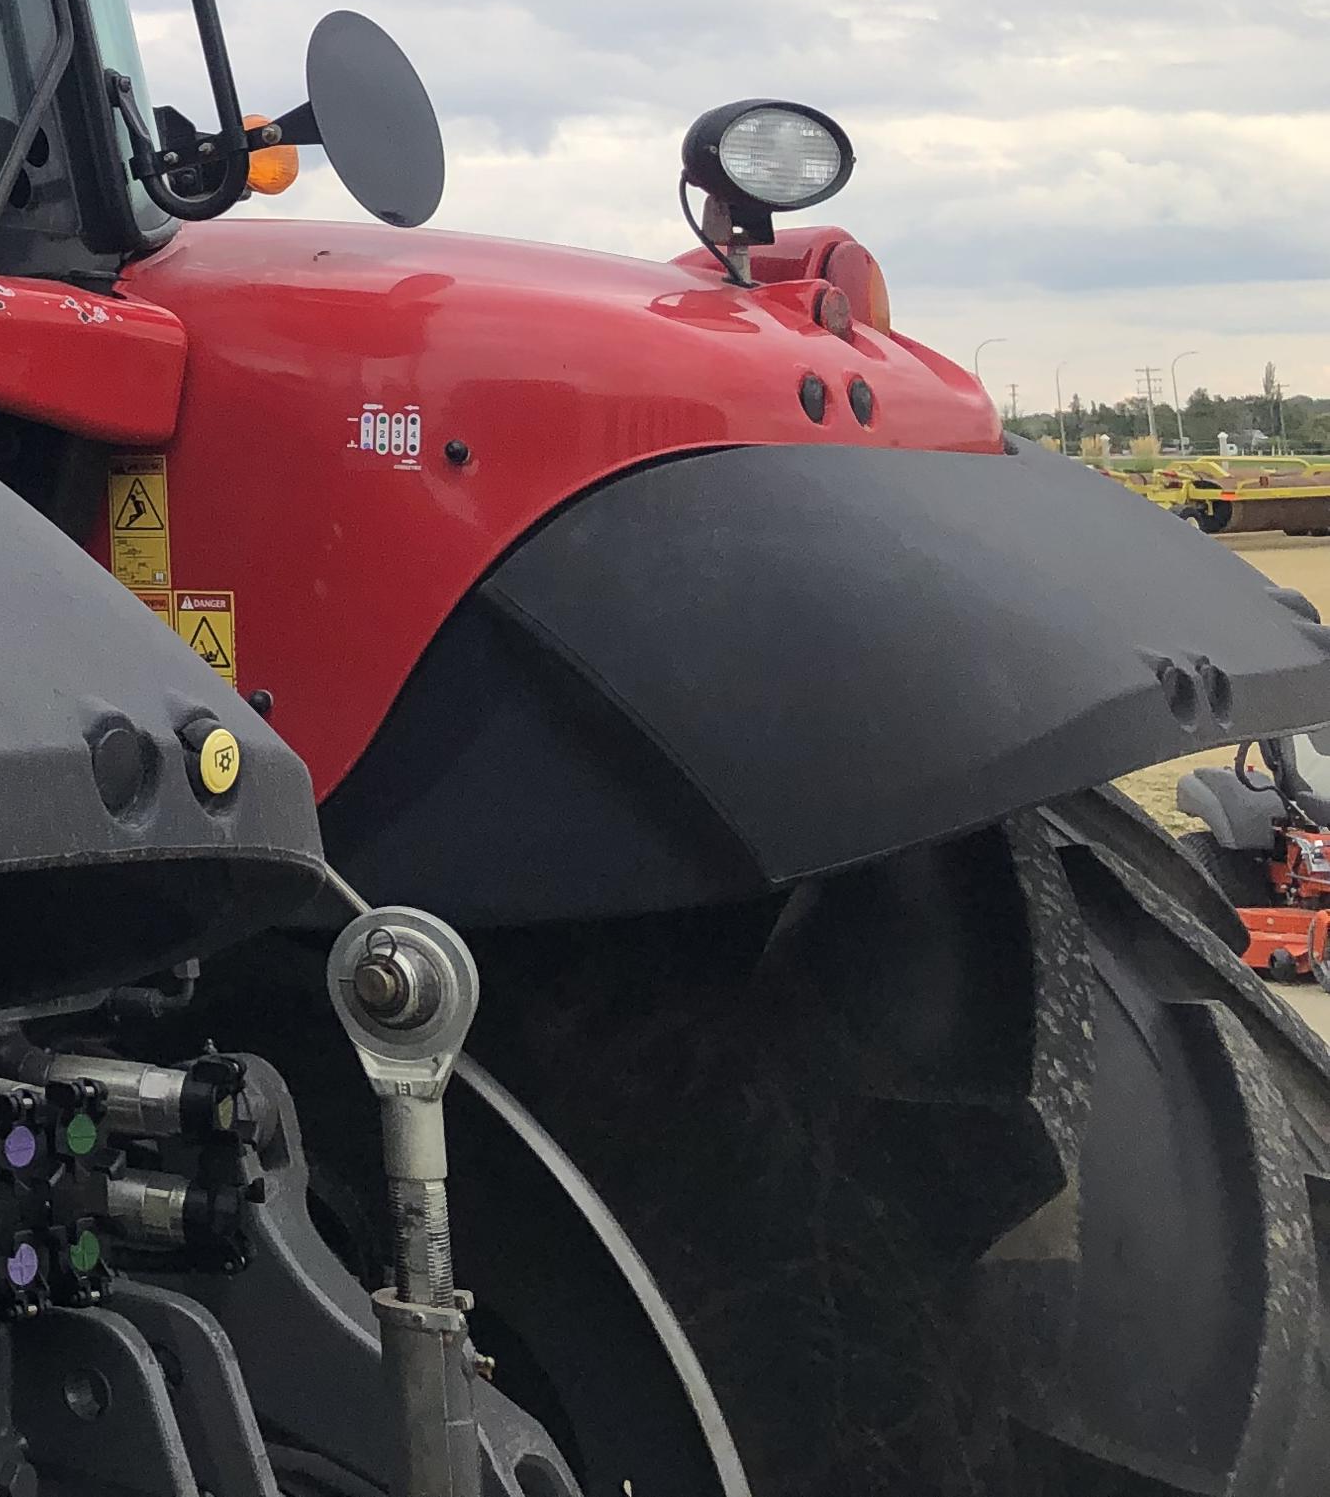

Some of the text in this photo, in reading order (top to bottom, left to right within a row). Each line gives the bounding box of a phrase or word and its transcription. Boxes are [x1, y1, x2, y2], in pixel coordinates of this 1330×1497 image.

[365, 430, 417, 440] 1 2 3 4
[193, 598, 227, 608] DANGER
